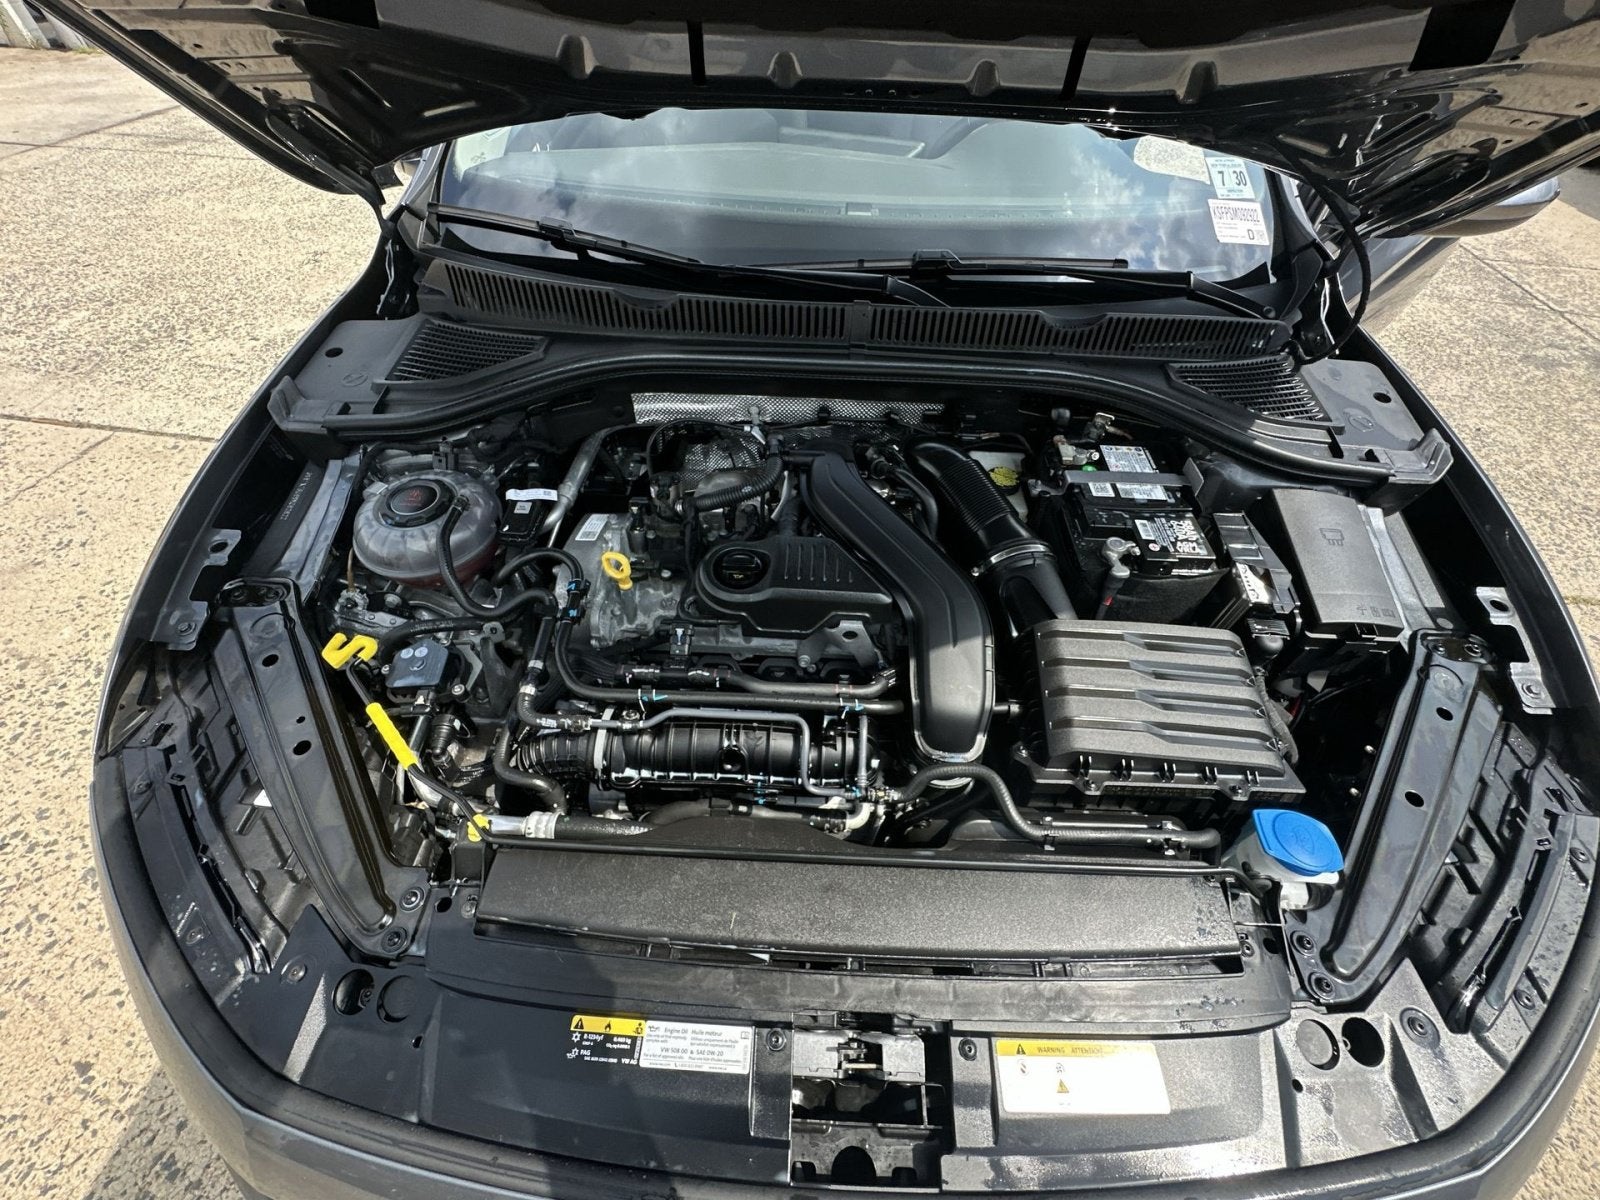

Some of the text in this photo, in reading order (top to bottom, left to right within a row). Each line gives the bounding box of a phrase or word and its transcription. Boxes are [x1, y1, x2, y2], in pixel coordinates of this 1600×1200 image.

[1217, 170, 1247, 187] 7 30
[1247, 228, 1255, 240] D
[664, 1027, 680, 1035] Engine
[1037, 1046, 1065, 1054] WARNING
